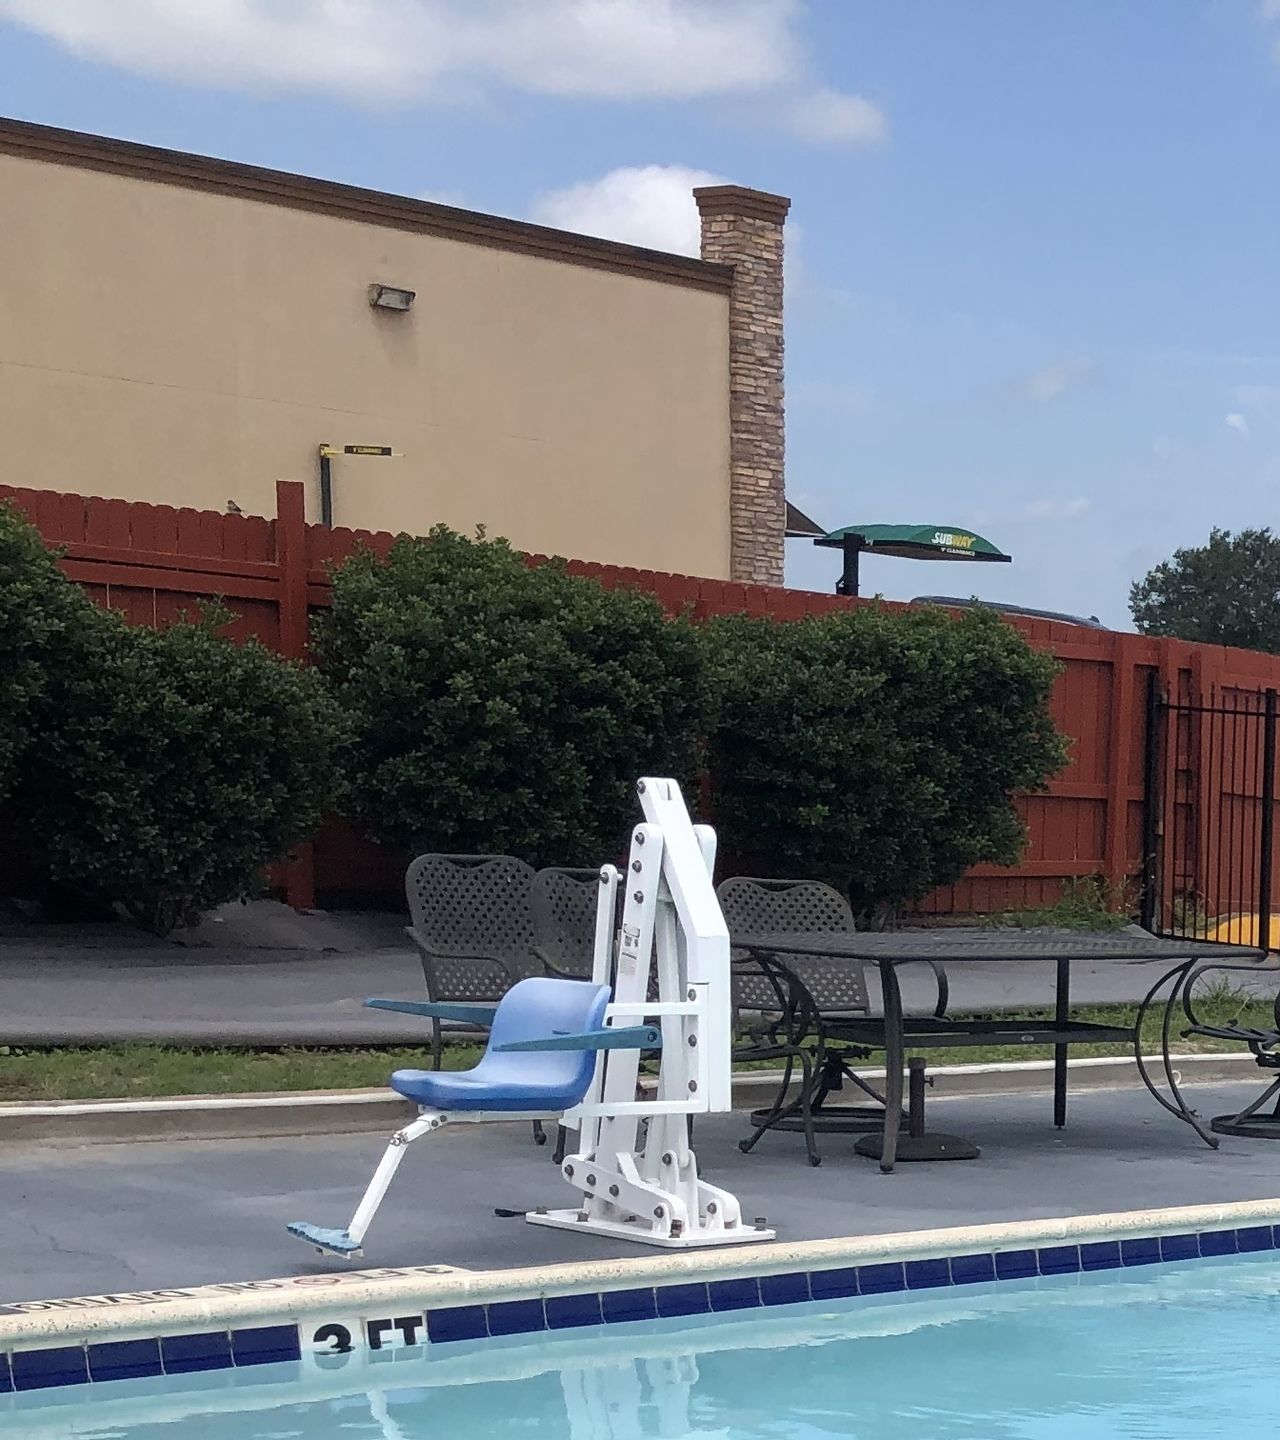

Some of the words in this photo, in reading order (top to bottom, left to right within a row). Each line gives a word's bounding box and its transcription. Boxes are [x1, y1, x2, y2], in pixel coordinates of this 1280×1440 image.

[931, 531, 976, 548] SUBWAY
[313, 1323, 355, 1356] 3
[366, 1315, 423, 1350] FT
